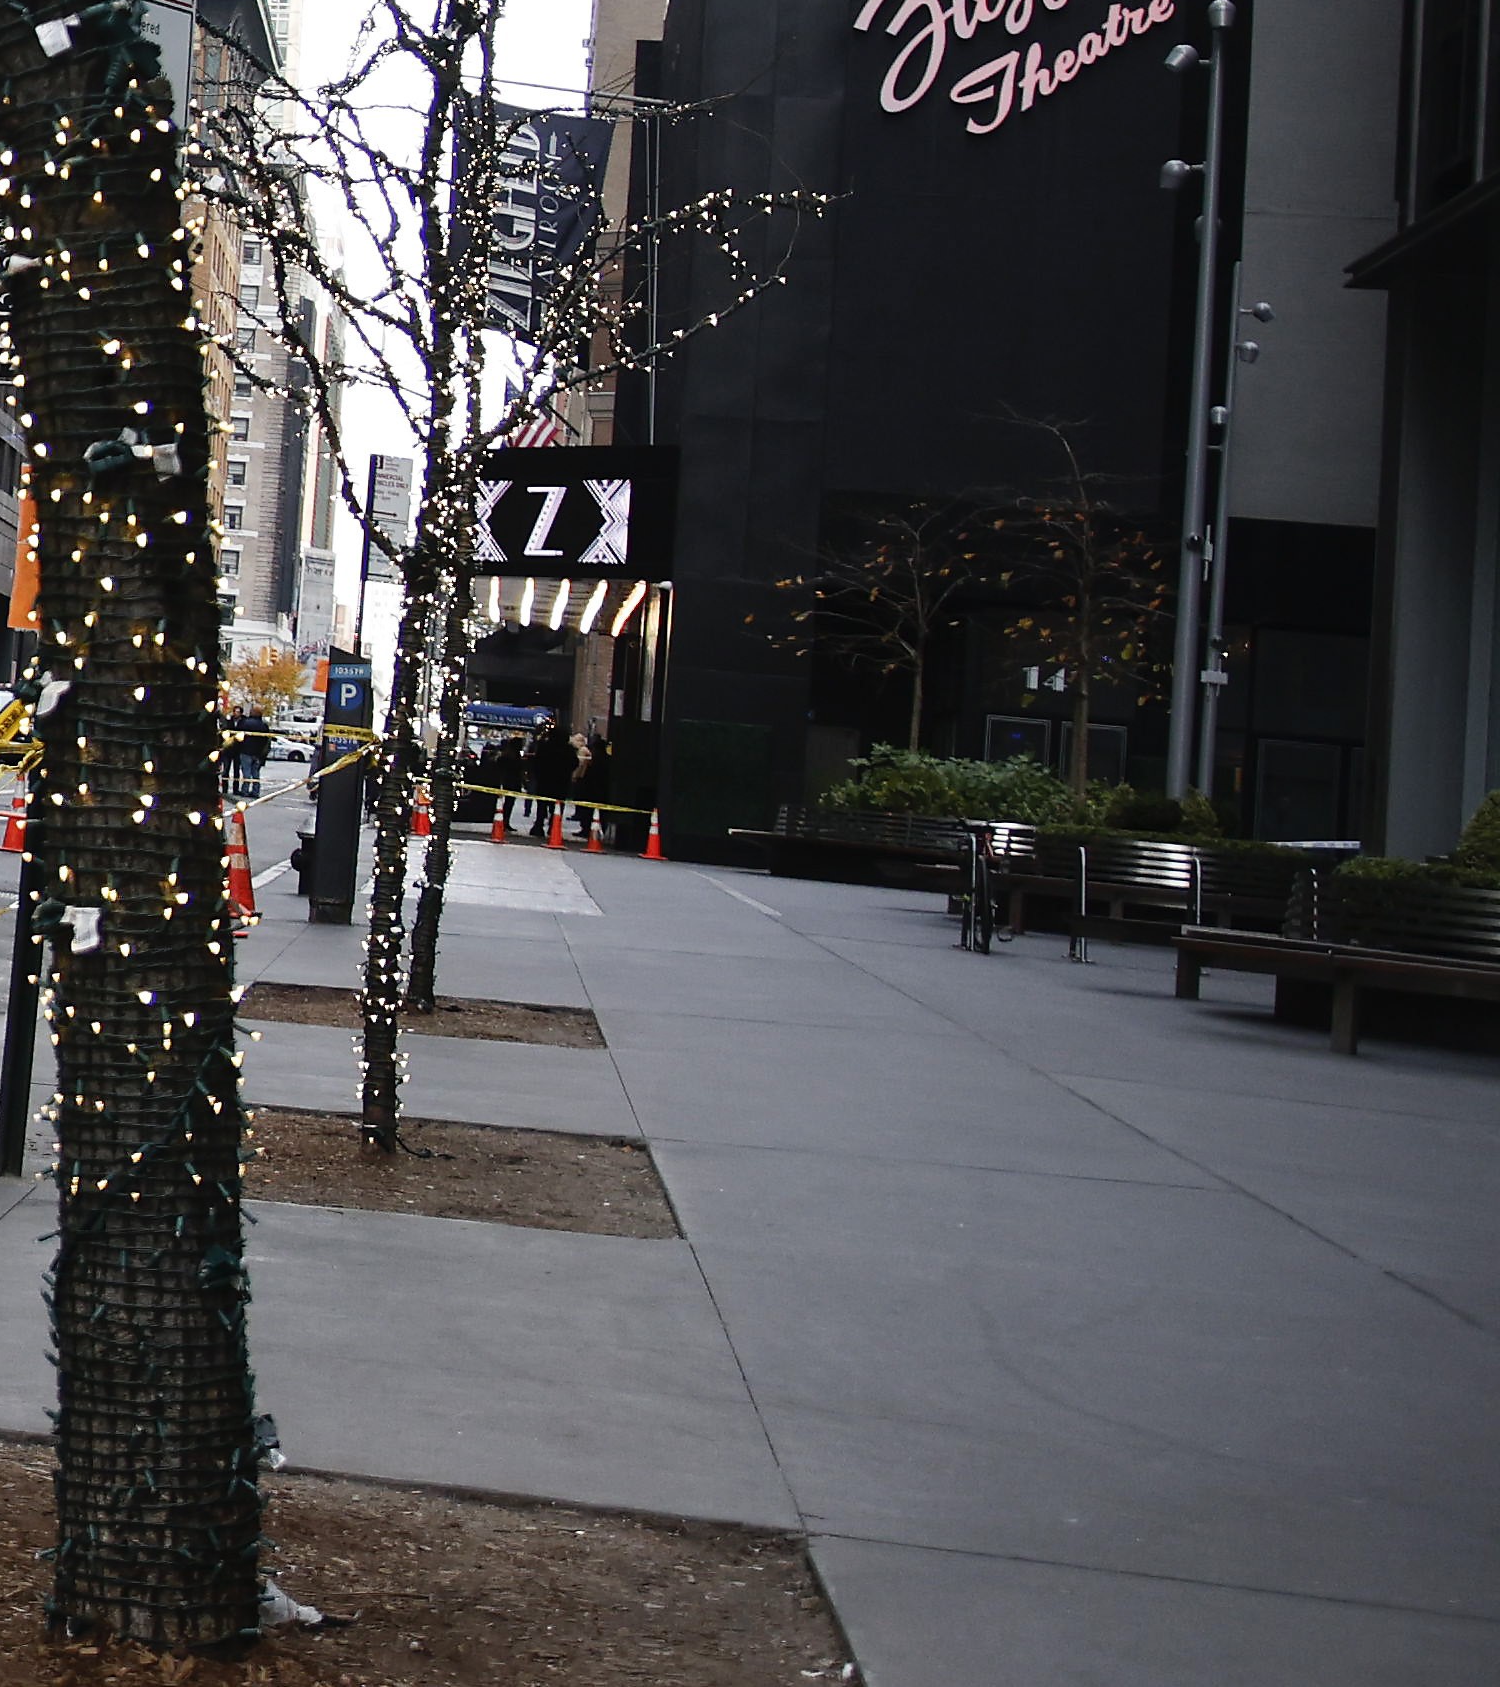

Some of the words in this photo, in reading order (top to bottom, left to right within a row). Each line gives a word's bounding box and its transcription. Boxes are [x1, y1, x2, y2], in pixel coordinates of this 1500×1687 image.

[140, 21, 160, 35] ered
[524, 487, 568, 556] Z
[340, 682, 357, 707] P
